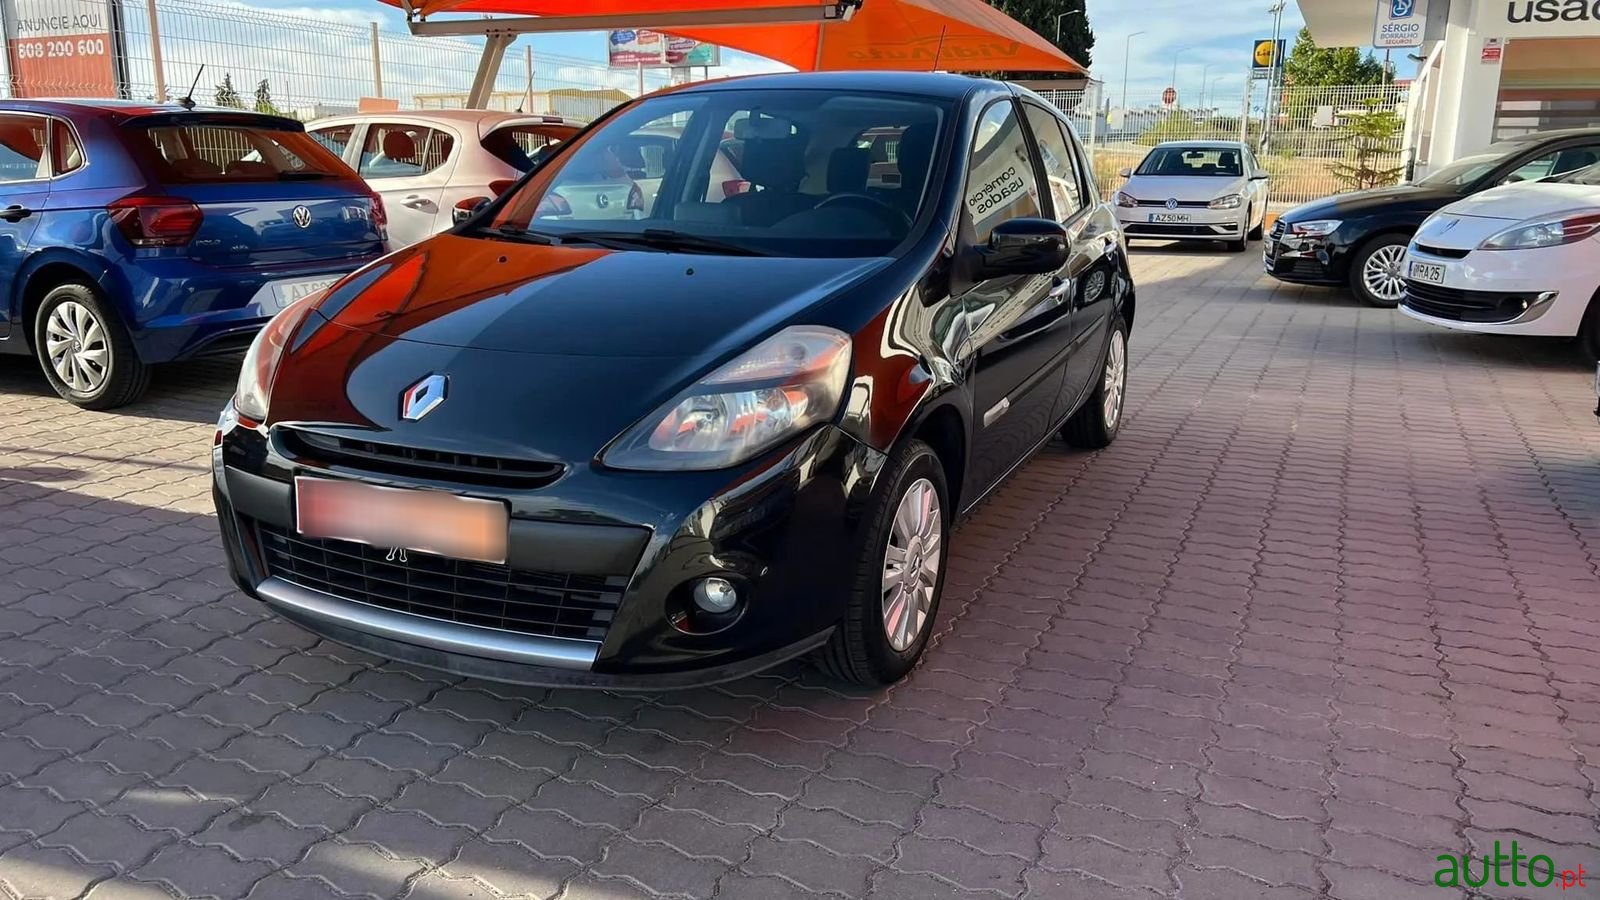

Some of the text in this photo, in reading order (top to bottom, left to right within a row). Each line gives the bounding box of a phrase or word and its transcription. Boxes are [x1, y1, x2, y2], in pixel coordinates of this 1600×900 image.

[17, 14, 102, 32] ANUNCIE AQUI
[1382, 22, 1420, 32] SÉRGIO
[46, 40, 74, 57] 200
[77, 38, 104, 56] 600
